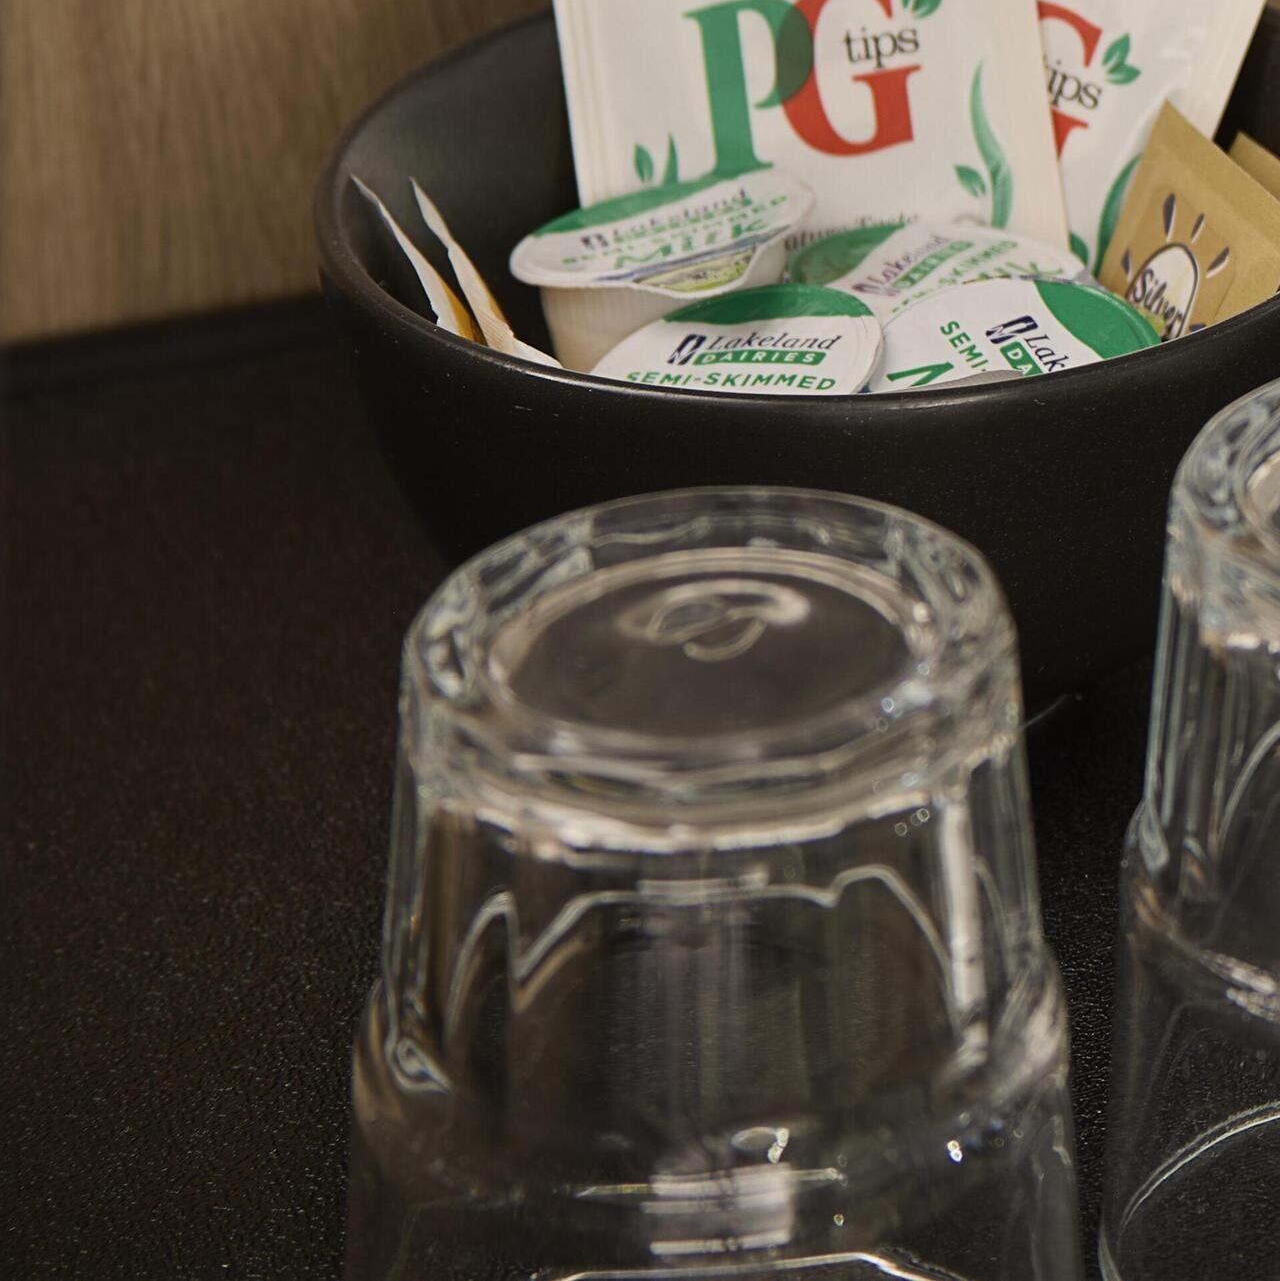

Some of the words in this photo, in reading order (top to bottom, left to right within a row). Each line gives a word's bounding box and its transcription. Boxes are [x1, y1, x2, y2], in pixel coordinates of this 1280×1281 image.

[842, 23, 920, 70] tips
[1044, 55, 1103, 110] ips
[1131, 267, 1185, 323] Silver
[701, 350, 817, 364] DAIRIES
[707, 331, 843, 351] Lakeland
[626, 371, 837, 391] SEMI-SKIMMED
